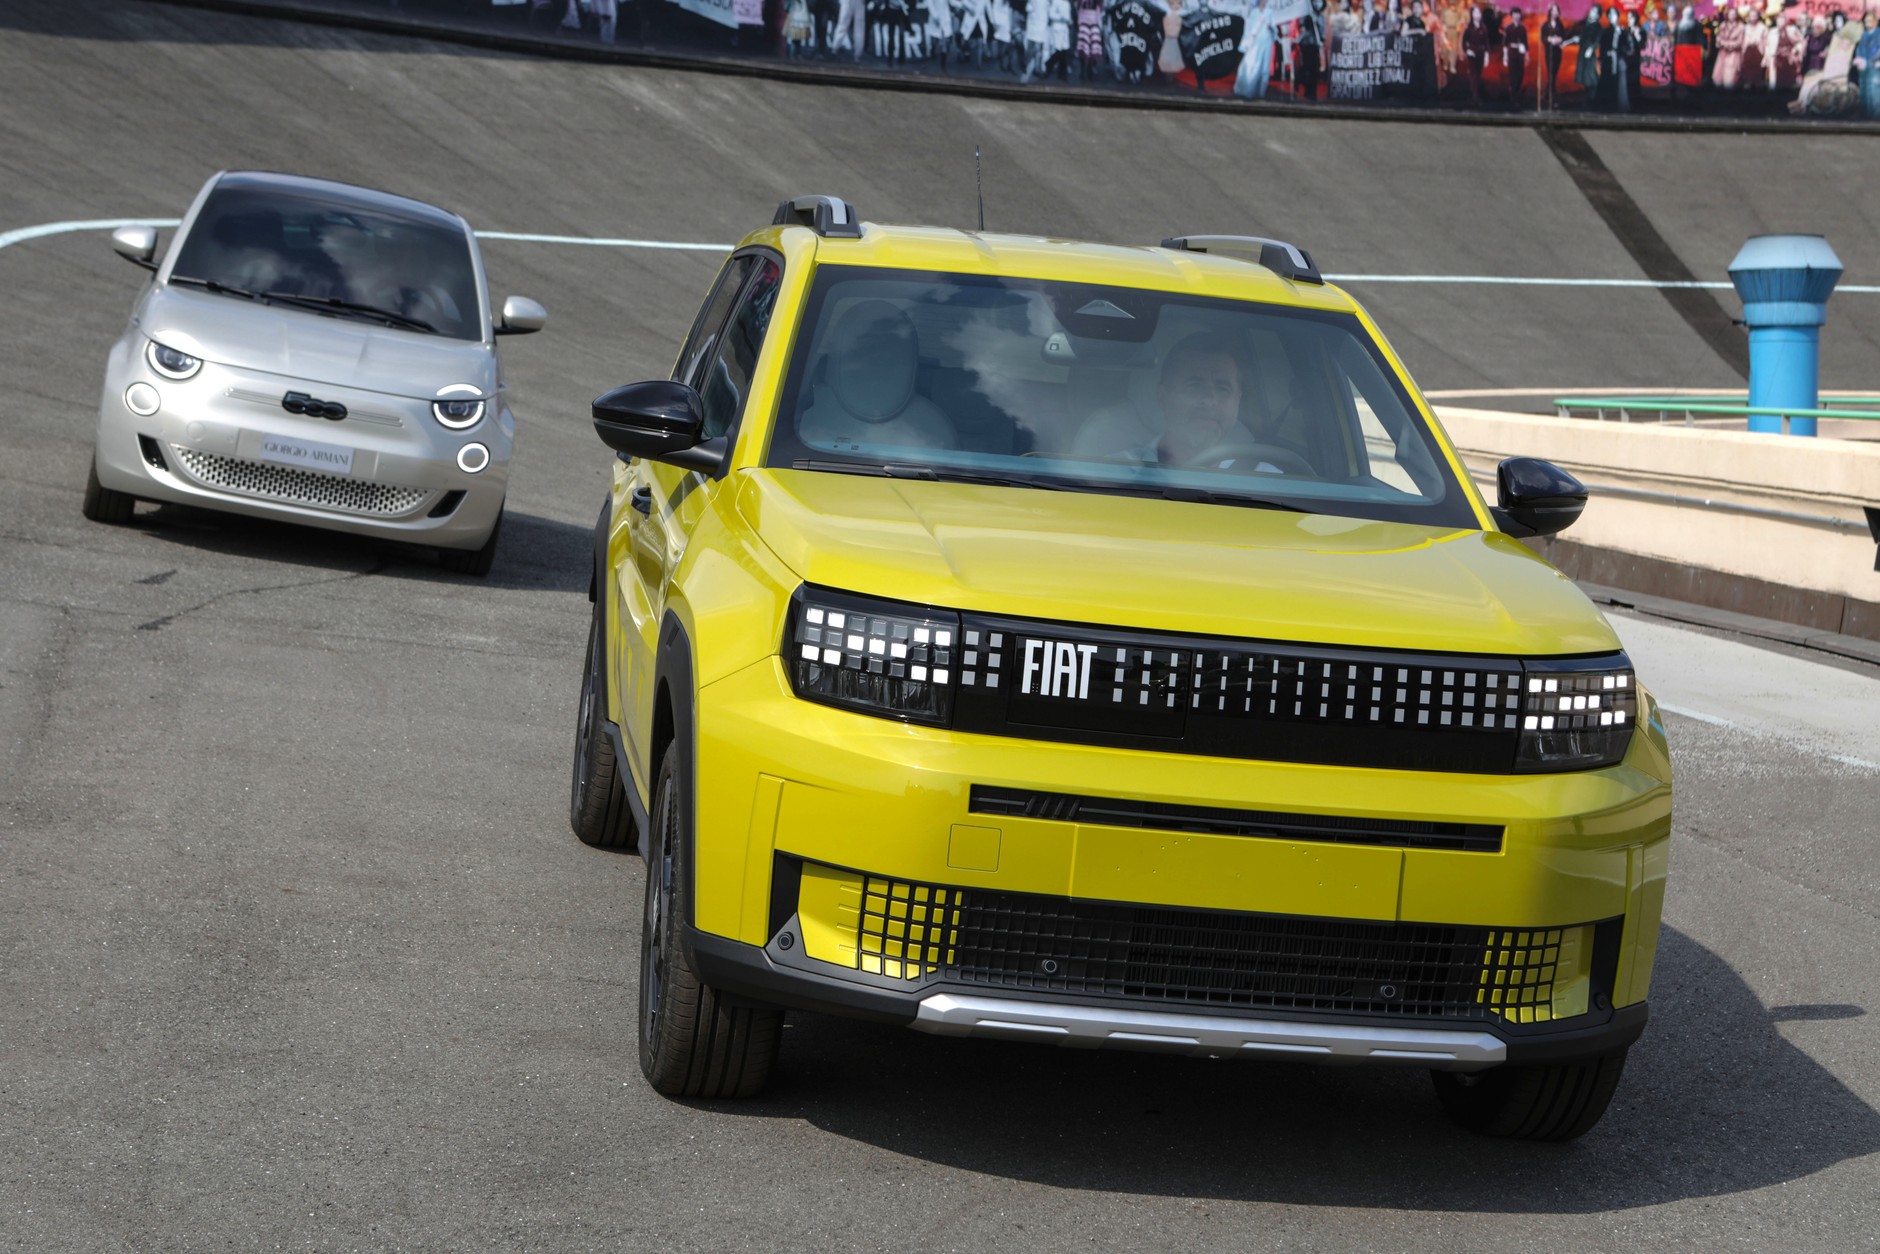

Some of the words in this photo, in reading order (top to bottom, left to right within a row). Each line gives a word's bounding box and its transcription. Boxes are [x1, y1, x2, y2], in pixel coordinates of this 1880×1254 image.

[1127, 17, 1136, 29] A
[1194, 15, 1232, 36] LAVORO
[1210, 31, 1217, 40] A
[1367, 49, 1402, 68] LIBERO
[1330, 67, 1411, 86] ANTICONCEZONALI
[282, 390, 348, 421] 500
[264, 442, 307, 457] GIORGIO
[311, 450, 349, 465] ARMANI
[1021, 639, 1098, 699] FIAT
